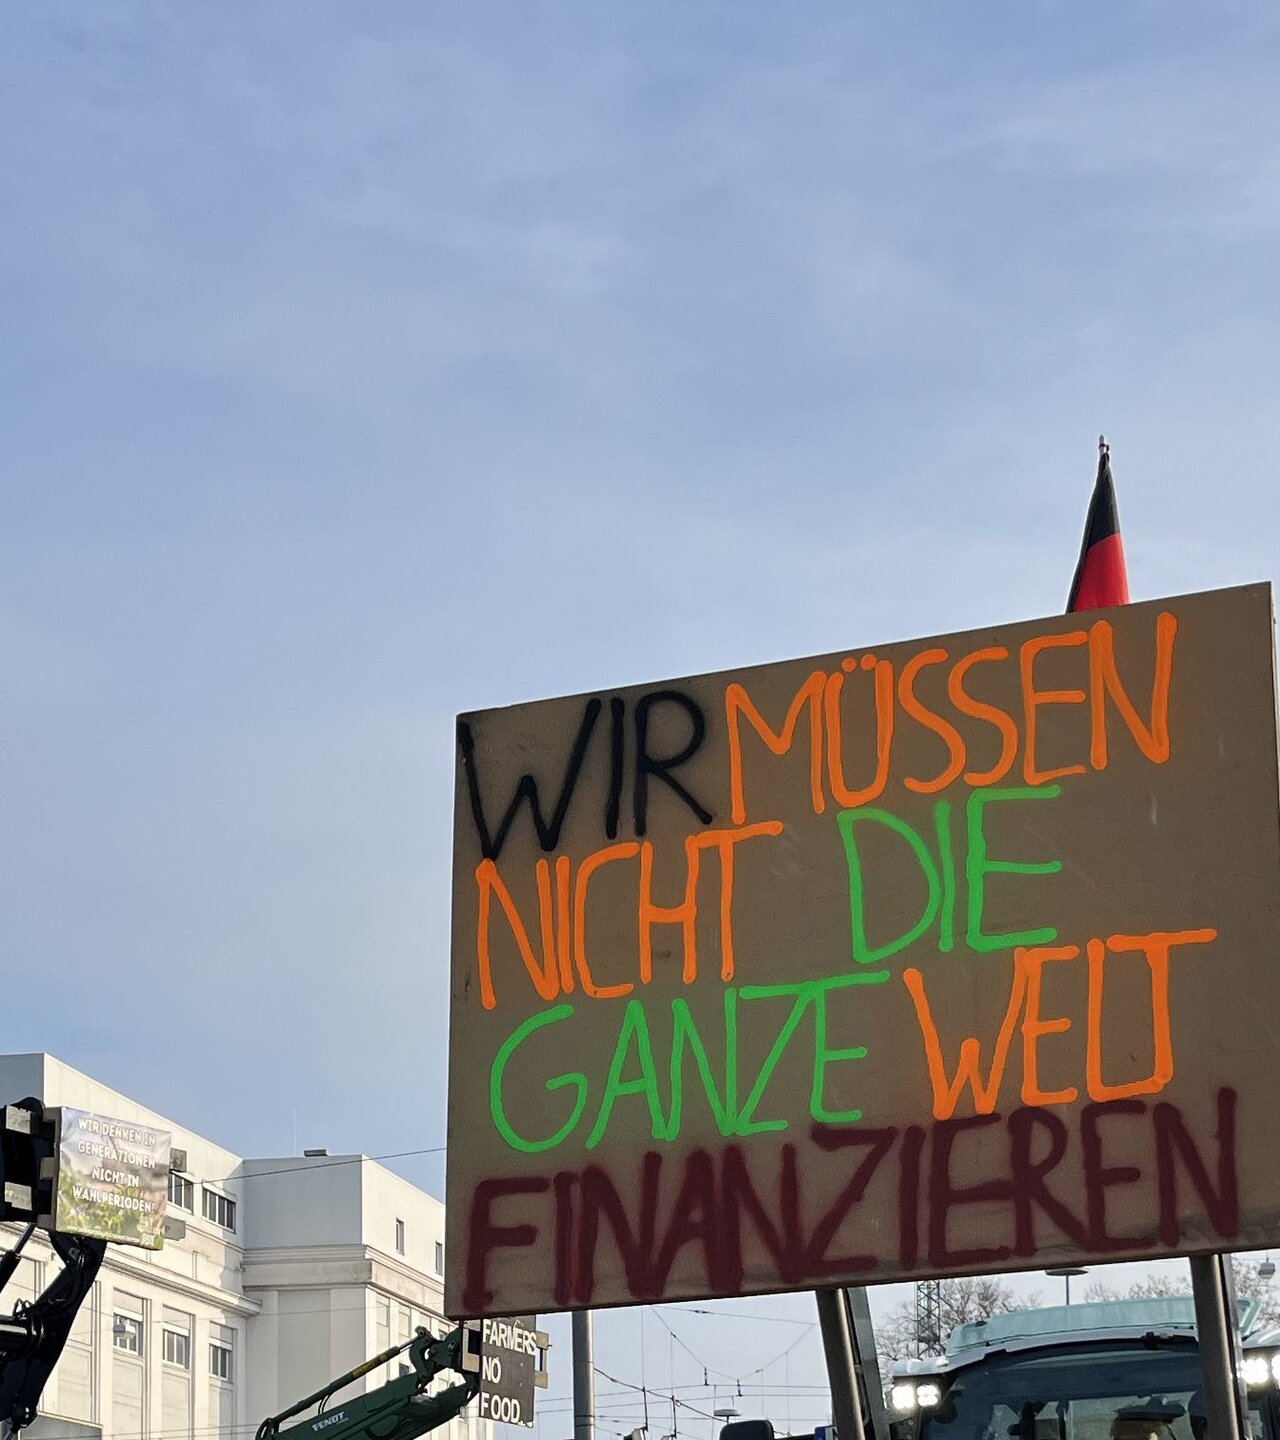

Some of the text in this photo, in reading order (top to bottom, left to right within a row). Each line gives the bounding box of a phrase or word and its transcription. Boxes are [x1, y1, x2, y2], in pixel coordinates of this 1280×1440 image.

[457, 611, 1179, 860] WIR MÜSSEN
[475, 783, 1063, 1010] NICHT DIE
[489, 928, 1218, 1154] GANZE WELT
[78, 1117, 156, 1146] WIR DENKEN IN
[77, 1140, 156, 1169] GENERATIONEN
[92, 1167, 139, 1187] NICHT IN
[72, 1185, 155, 1213] WAHLPERIODEN!
[461, 1086, 1239, 1309] FINANZIEREN
[483, 1318, 537, 1355] FARMERS
[482, 1356, 501, 1384] NO
[312, 1411, 345, 1432] FENDT
